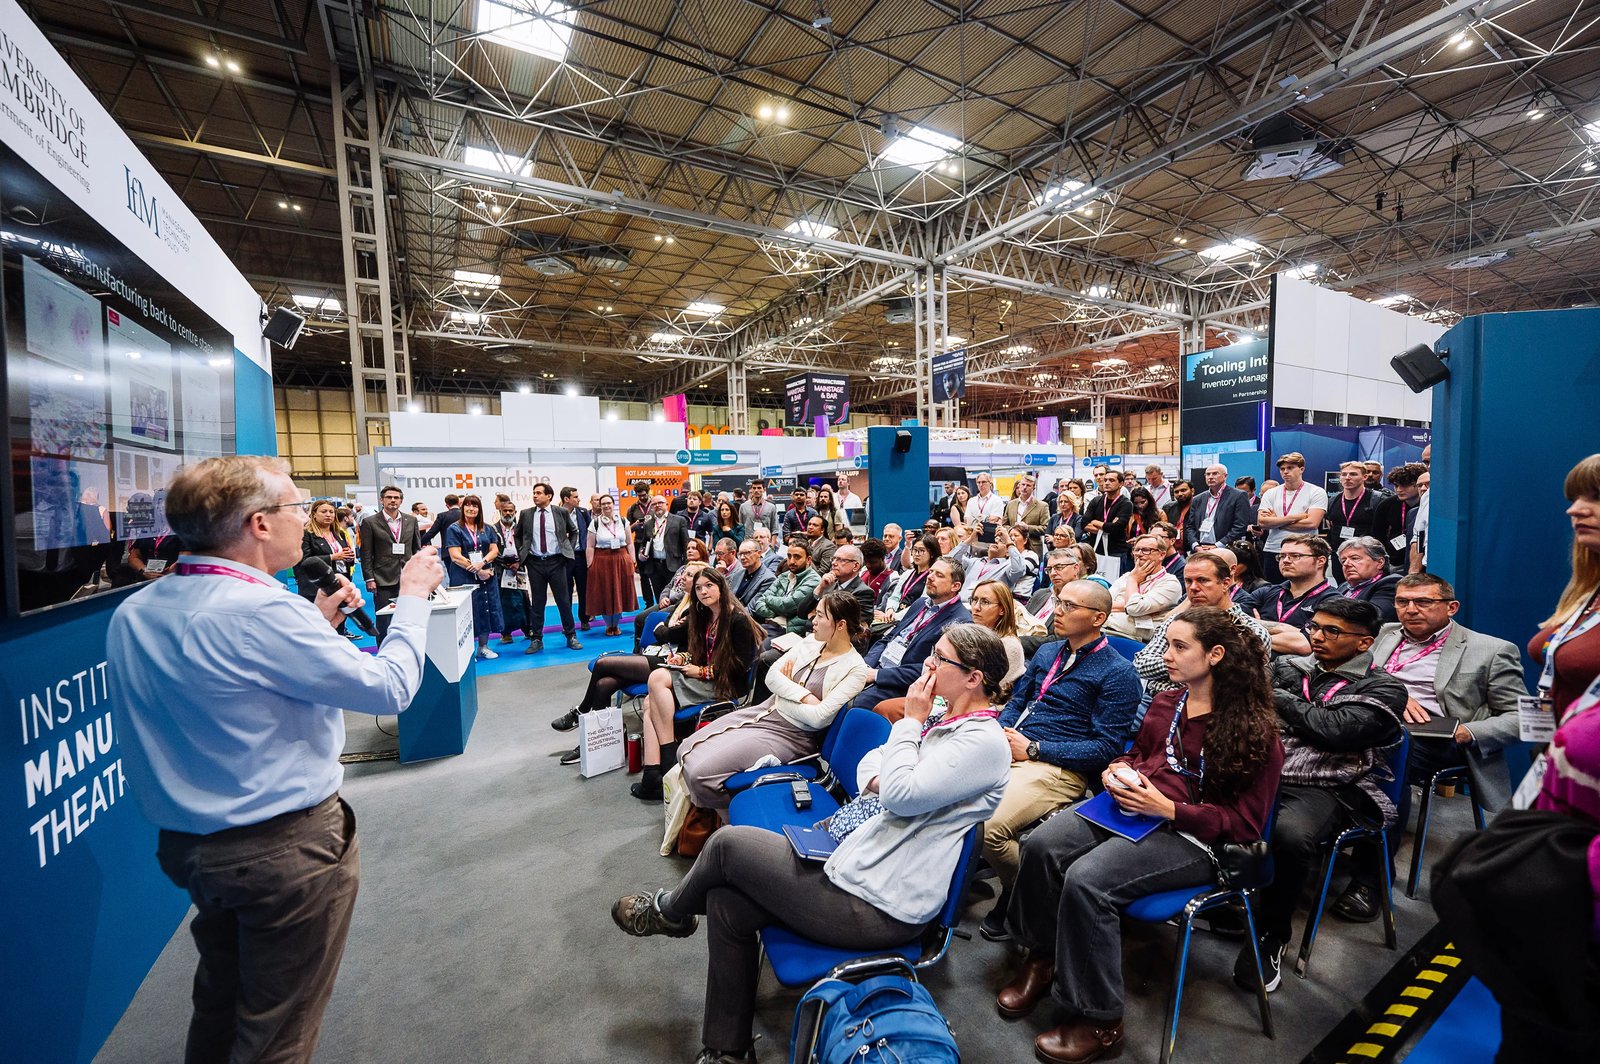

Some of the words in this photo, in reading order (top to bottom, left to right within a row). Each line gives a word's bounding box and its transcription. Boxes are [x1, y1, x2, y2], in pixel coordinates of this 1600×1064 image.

[69, 106, 86, 137] OF
[35, 133, 45, 152] of
[46, 140, 92, 194] Engineering
[123, 164, 160, 239] IfM
[149, 297, 169, 327] back
[169, 314, 178, 332] to
[178, 323, 199, 347] centre
[199, 337, 215, 354] stage
[1201, 360, 1246, 376] Tooling
[1250, 354, 1269, 367] Int
[814, 385, 844, 393] MAINSTAGE
[1201, 377, 1237, 389] Inventory
[1239, 389, 1268, 398] Partnership
[407, 475, 453, 489] man
[475, 469, 551, 488] machine
[587, 731, 611, 742] COMPANY
[587, 736, 616, 747] INDUSTRIAL
[587, 739, 620, 752] ELECTRONICS
